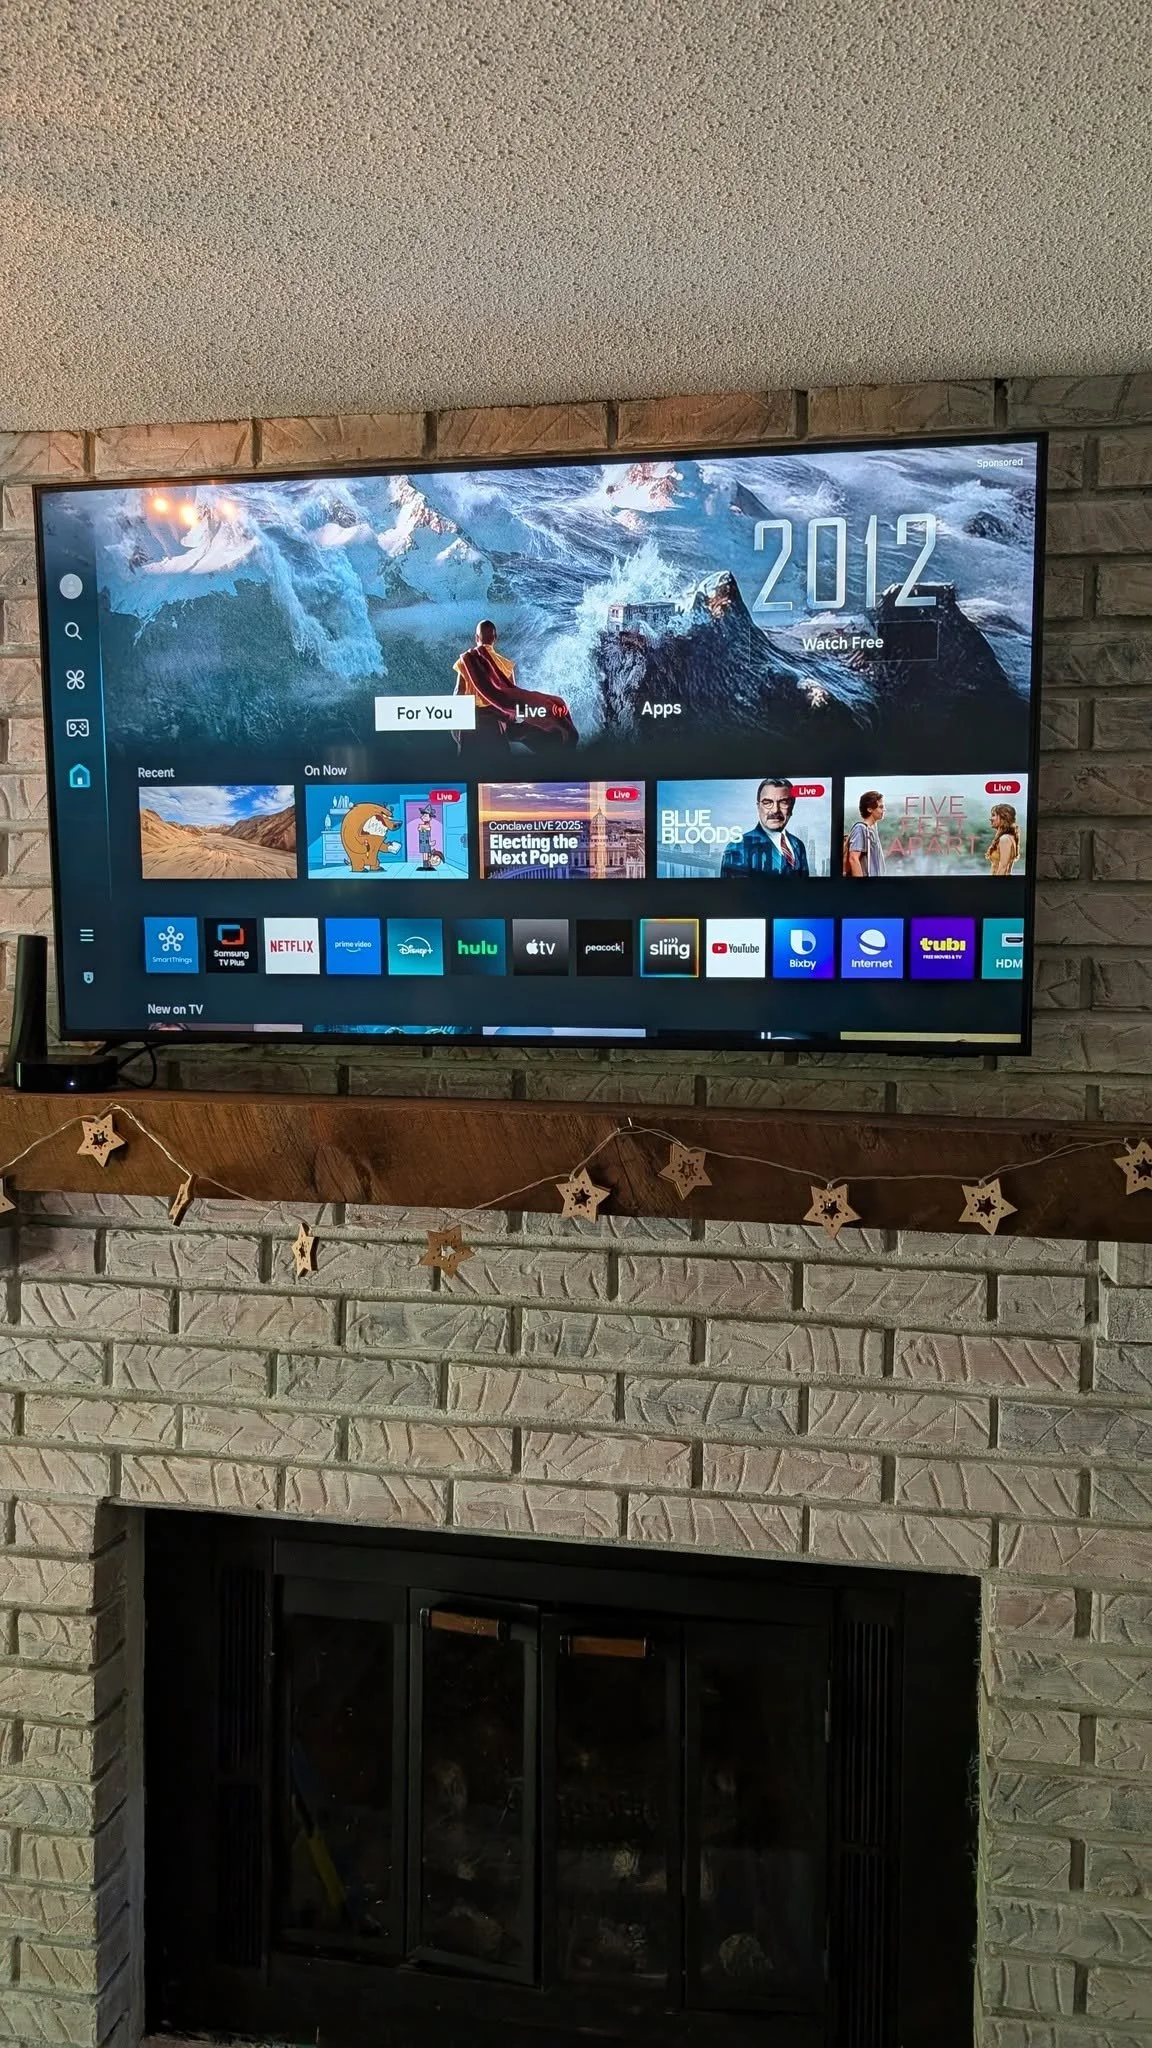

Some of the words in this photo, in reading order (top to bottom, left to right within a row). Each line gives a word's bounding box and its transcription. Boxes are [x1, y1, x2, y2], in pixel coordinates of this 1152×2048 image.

[976, 457, 1024, 469] Sponsored
[752, 513, 937, 612] 2012
[803, 636, 848, 650] Watch
[852, 636, 884, 649] Free
[397, 707, 421, 720] For
[425, 706, 453, 720] You
[515, 703, 547, 718] Live
[641, 701, 682, 719] Apps
[138, 767, 175, 778] Recent
[304, 765, 321, 776] On
[323, 765, 347, 776] Now
[799, 787, 816, 796] Live
[993, 783, 1012, 792] Live
[436, 792, 453, 801] Live
[613, 790, 630, 799] Live
[904, 795, 965, 815] FIVE
[662, 809, 712, 827] BLUE
[489, 821, 533, 831] Conclave
[534, 821, 554, 831] LIVE
[555, 820, 583, 830] 2025:
[900, 816, 968, 835] FEET
[661, 825, 743, 844] BLOODS
[490, 834, 552, 851] Electing
[553, 834, 578, 849] the
[886, 836, 980, 856] APART
[490, 850, 531, 865] Next
[532, 850, 569, 867] Pope
[270, 939, 314, 953] NETFLIX
[335, 941, 351, 950] prime
[352, 941, 372, 949] video
[457, 940, 498, 955] hulu
[540, 941, 556, 955] tv
[585, 943, 622, 955] peacock
[650, 940, 690, 959] sling
[728, 943, 760, 954] YouTube
[919, 937, 967, 951] tubi
[152, 956, 193, 965] SmartThings
[214, 950, 249, 960] Samsung
[219, 959, 228, 967] TV
[229, 959, 245, 967] Plus
[789, 959, 817, 970] Bixby
[851, 959, 893, 968] Internet
[147, 1003, 171, 1015] New
[173, 1006, 186, 1015] on
[188, 1003, 204, 1015] TV
